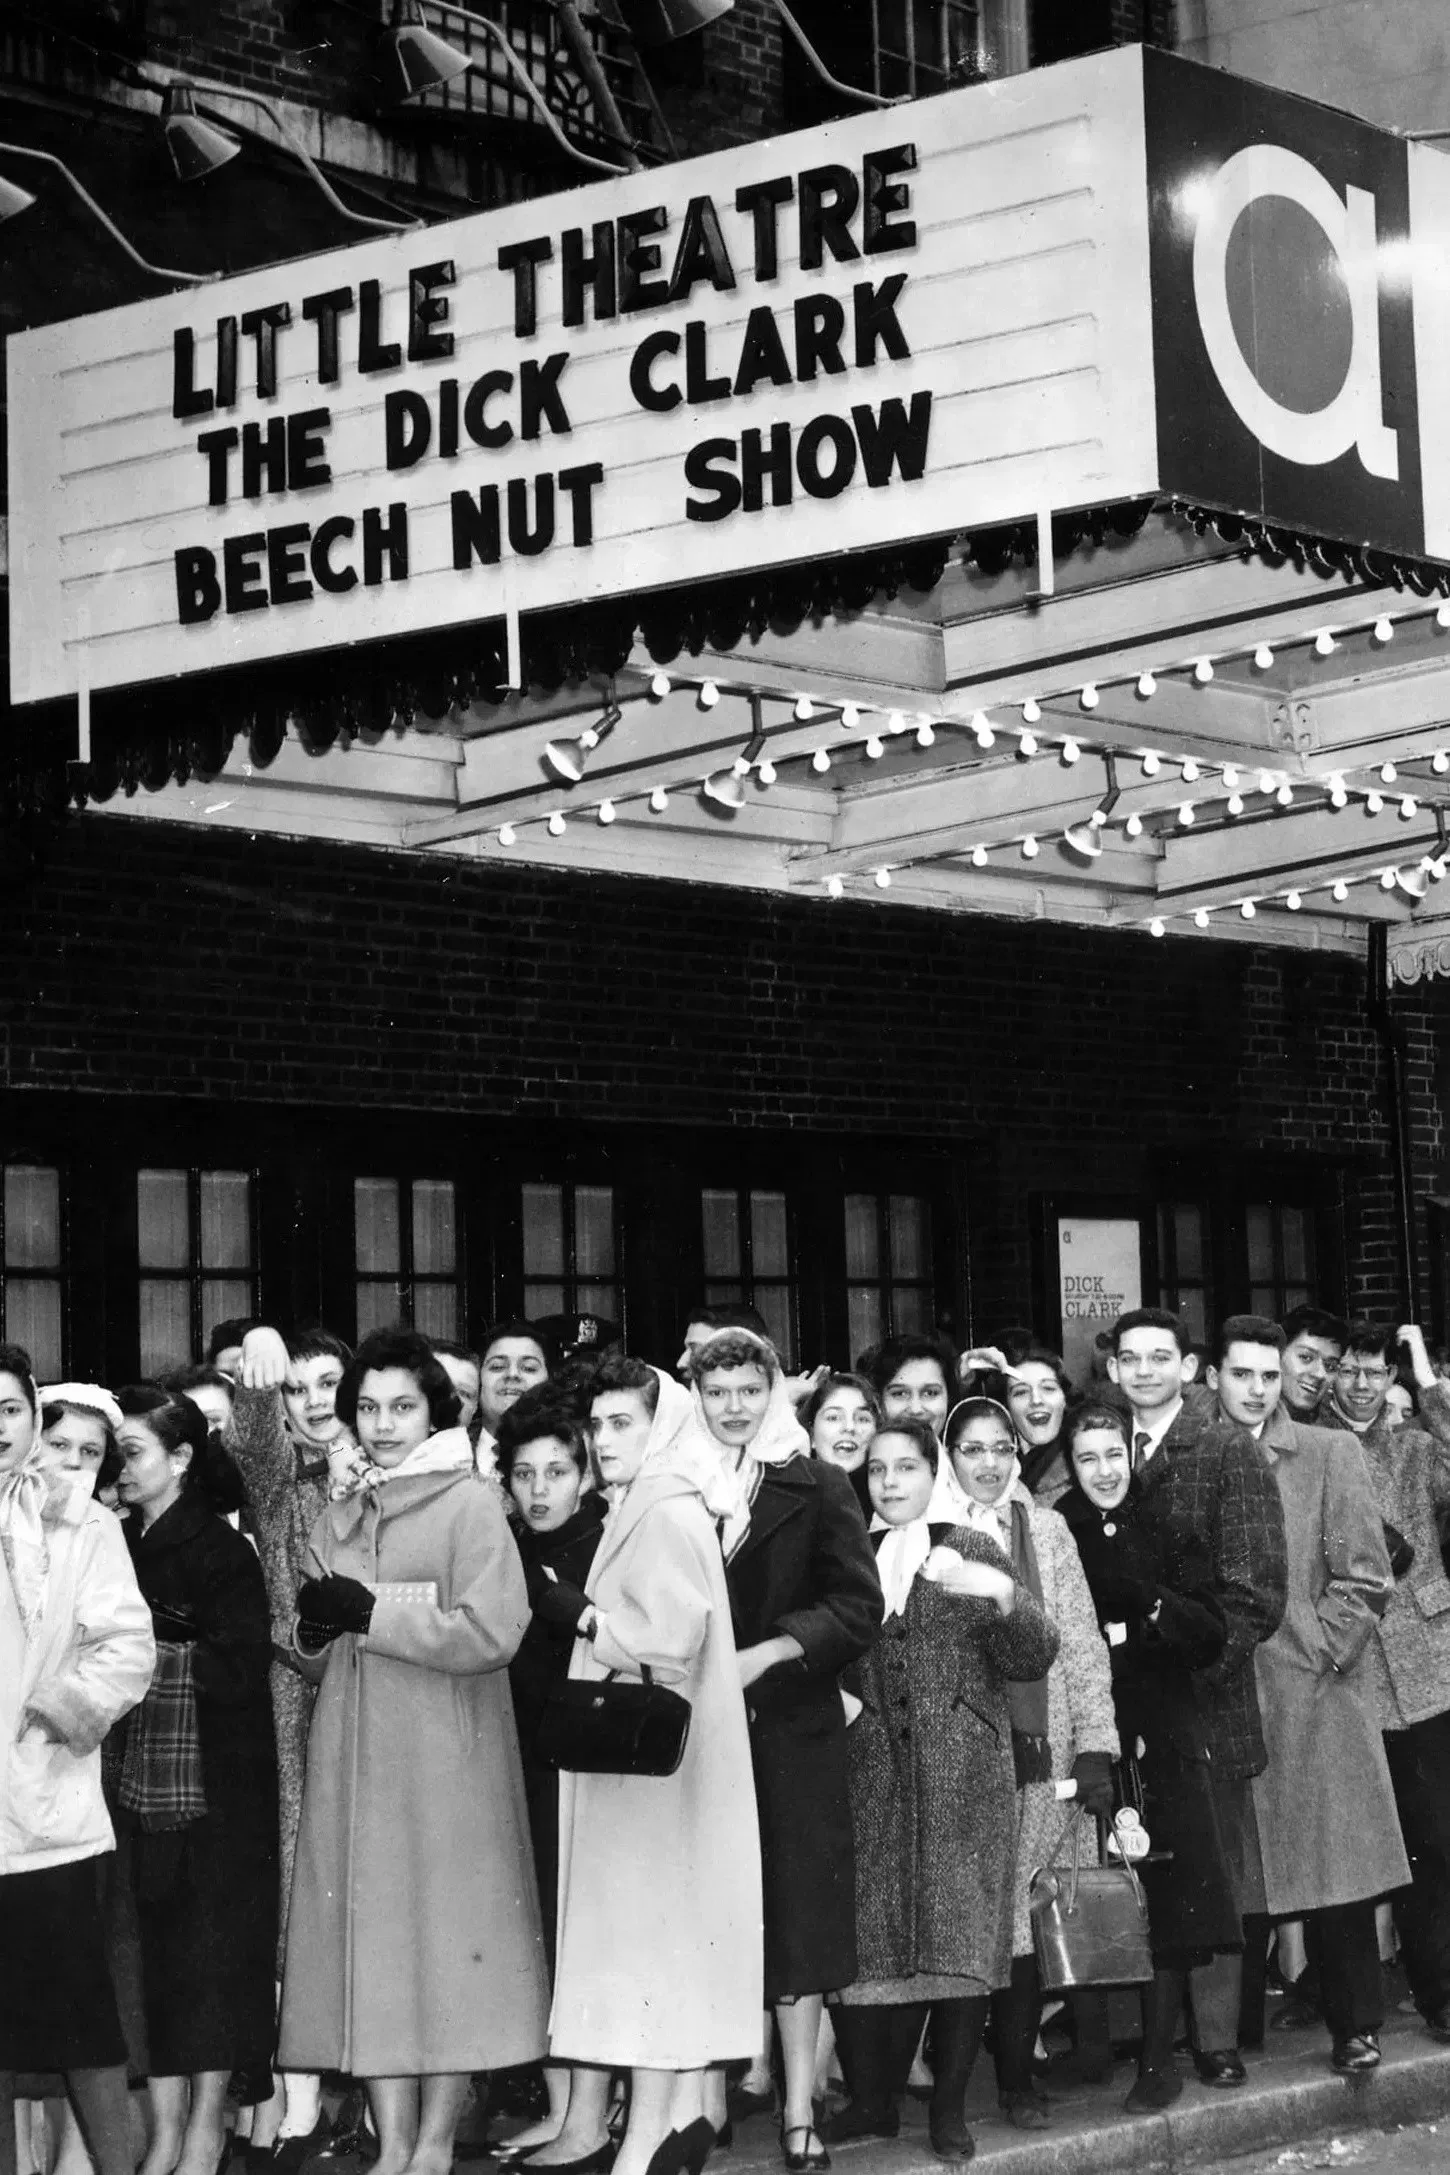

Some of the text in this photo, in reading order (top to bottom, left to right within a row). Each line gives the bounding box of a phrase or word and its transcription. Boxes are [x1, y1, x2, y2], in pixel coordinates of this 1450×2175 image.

[173, 144, 918, 420] LITTLE THEATRE
[198, 274, 912, 507] THE DICK CLARK
[174, 391, 933, 625] BEECH NUT SHOW
[1064, 1276, 1104, 1292] DICK
[1065, 1301, 1122, 1318] CLARK
